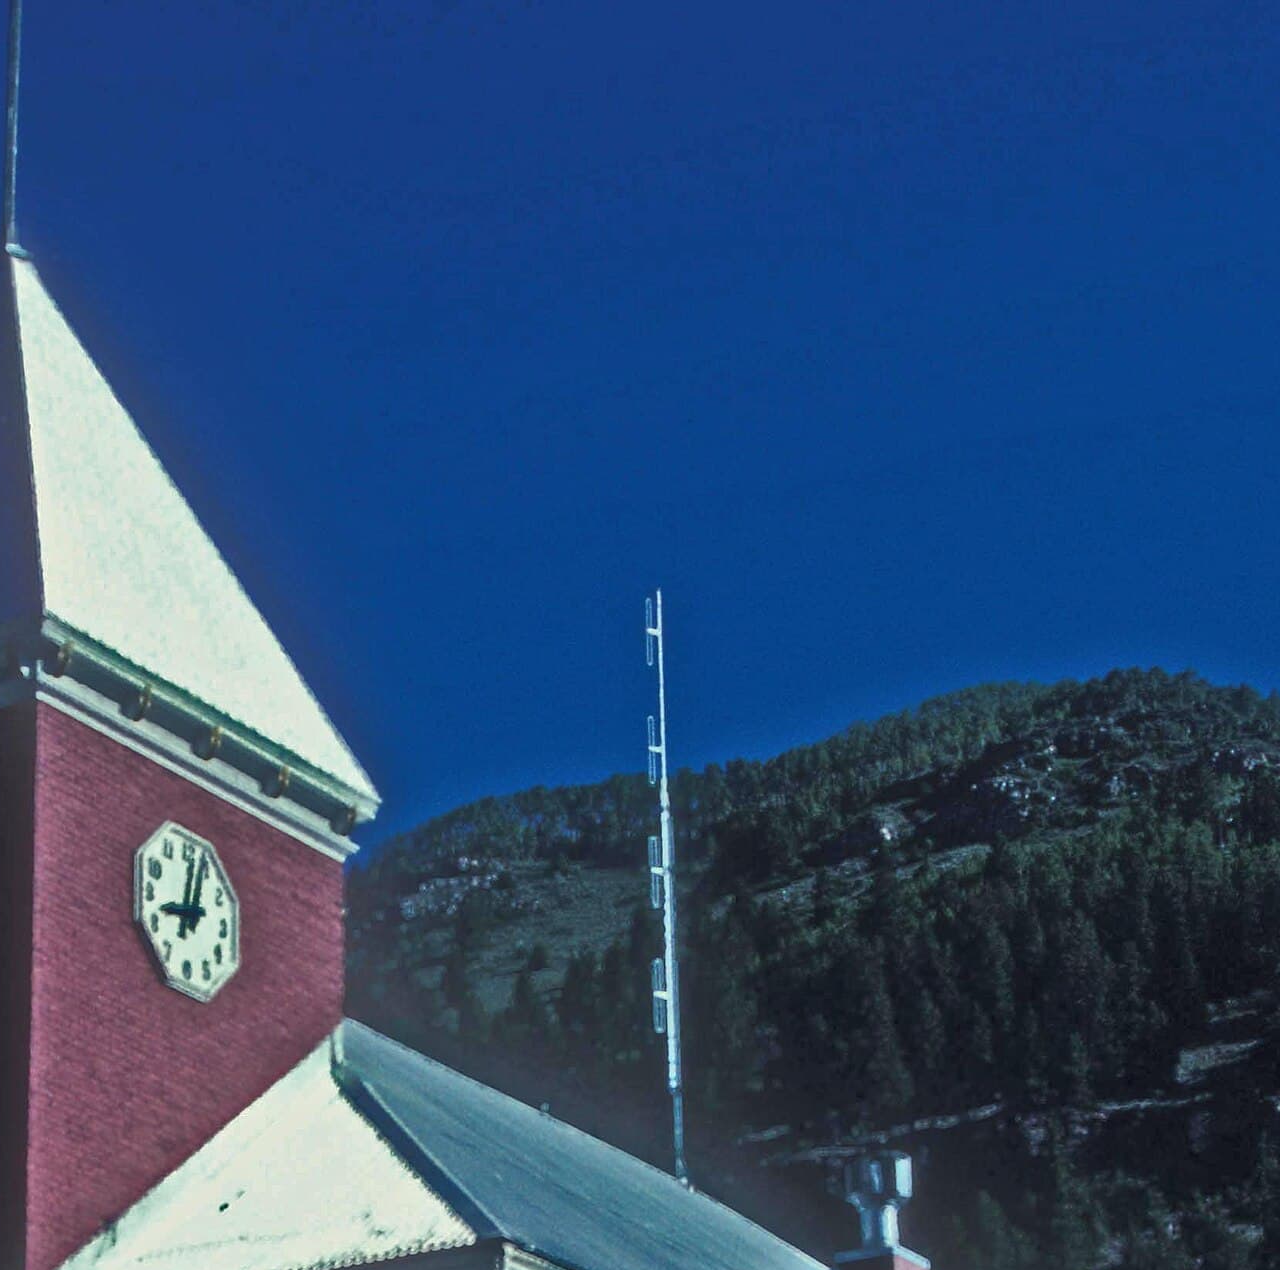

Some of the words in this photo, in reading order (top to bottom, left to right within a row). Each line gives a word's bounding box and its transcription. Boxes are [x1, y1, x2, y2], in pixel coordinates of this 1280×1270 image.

[163, 838, 173, 860] 11
[182, 842, 195, 862] 12
[148, 857, 162, 880] 10
[215, 886, 223, 906] 2
[163, 940, 171, 962] 7
[202, 958, 211, 981] 5
